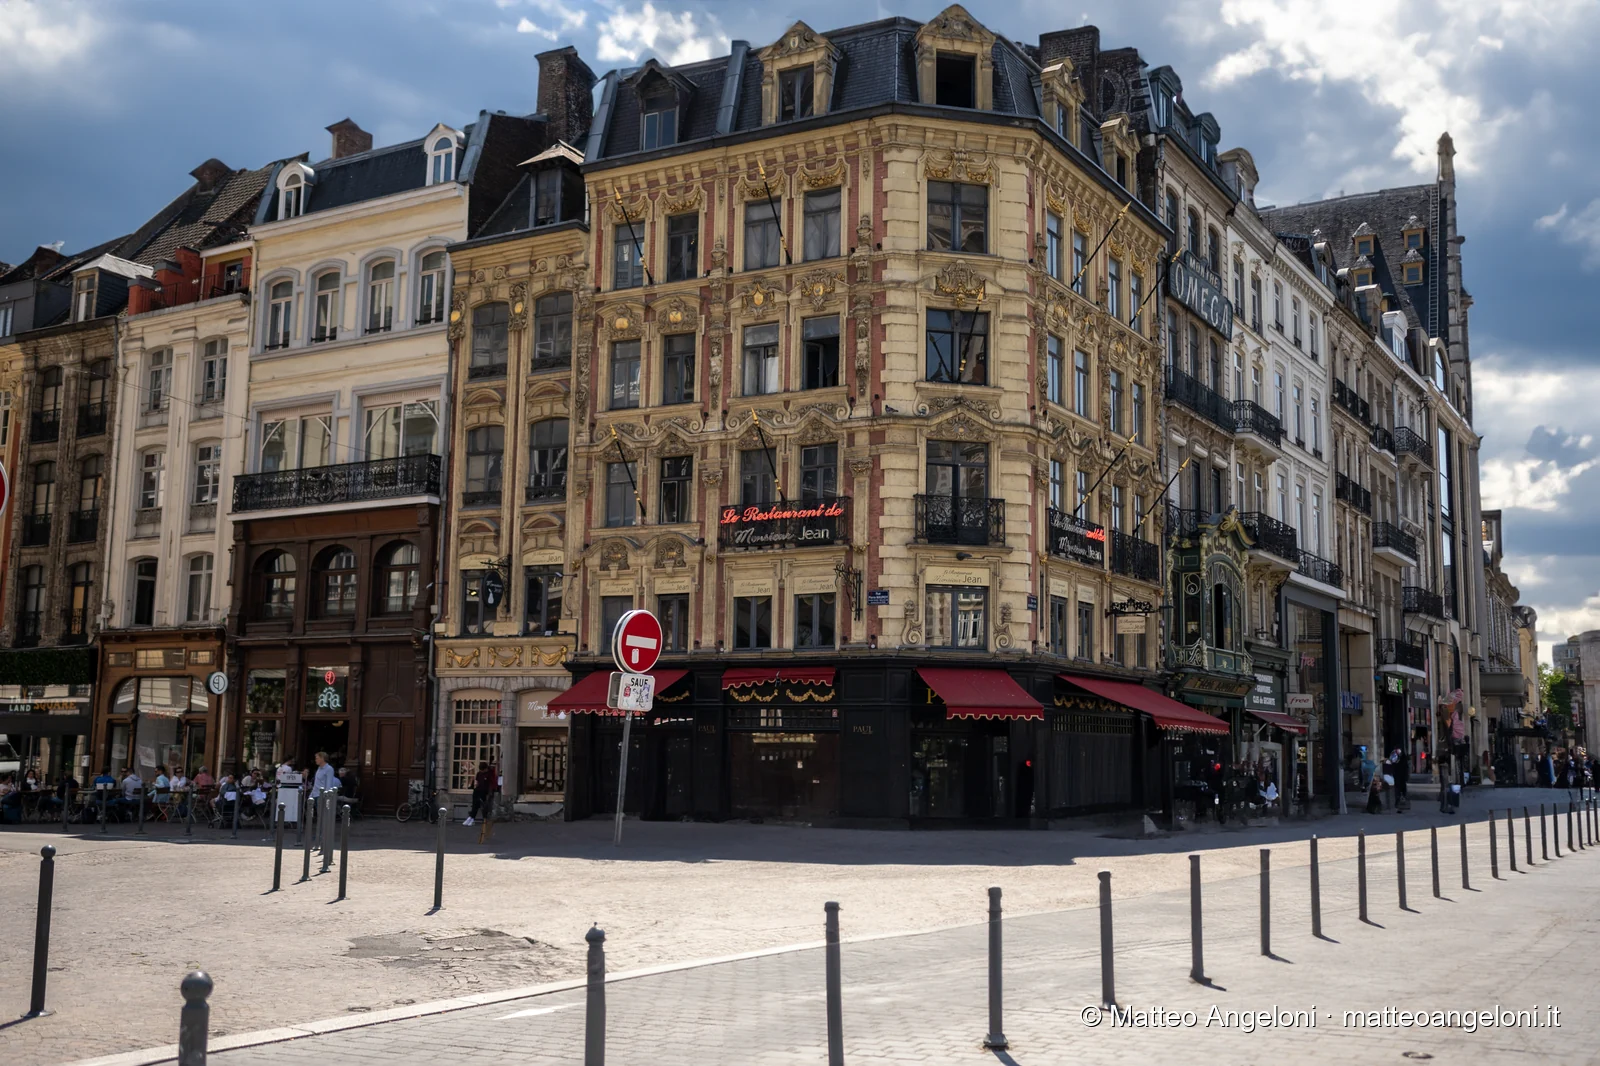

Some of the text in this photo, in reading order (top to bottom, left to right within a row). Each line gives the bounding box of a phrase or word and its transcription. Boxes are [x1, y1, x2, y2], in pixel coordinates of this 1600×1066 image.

[1175, 263, 1229, 335] OMEGA
[721, 500, 844, 524] Le Restaurant de
[734, 525, 830, 544] Monsieur Jean
[962, 575, 982, 583] Jean
[631, 677, 649, 687] SAUF
[34, 699, 76, 710] SQUARE
[1290, 696, 1309, 704] free
[9, 704, 31, 712] LAND
[853, 725, 872, 733] PAUL
